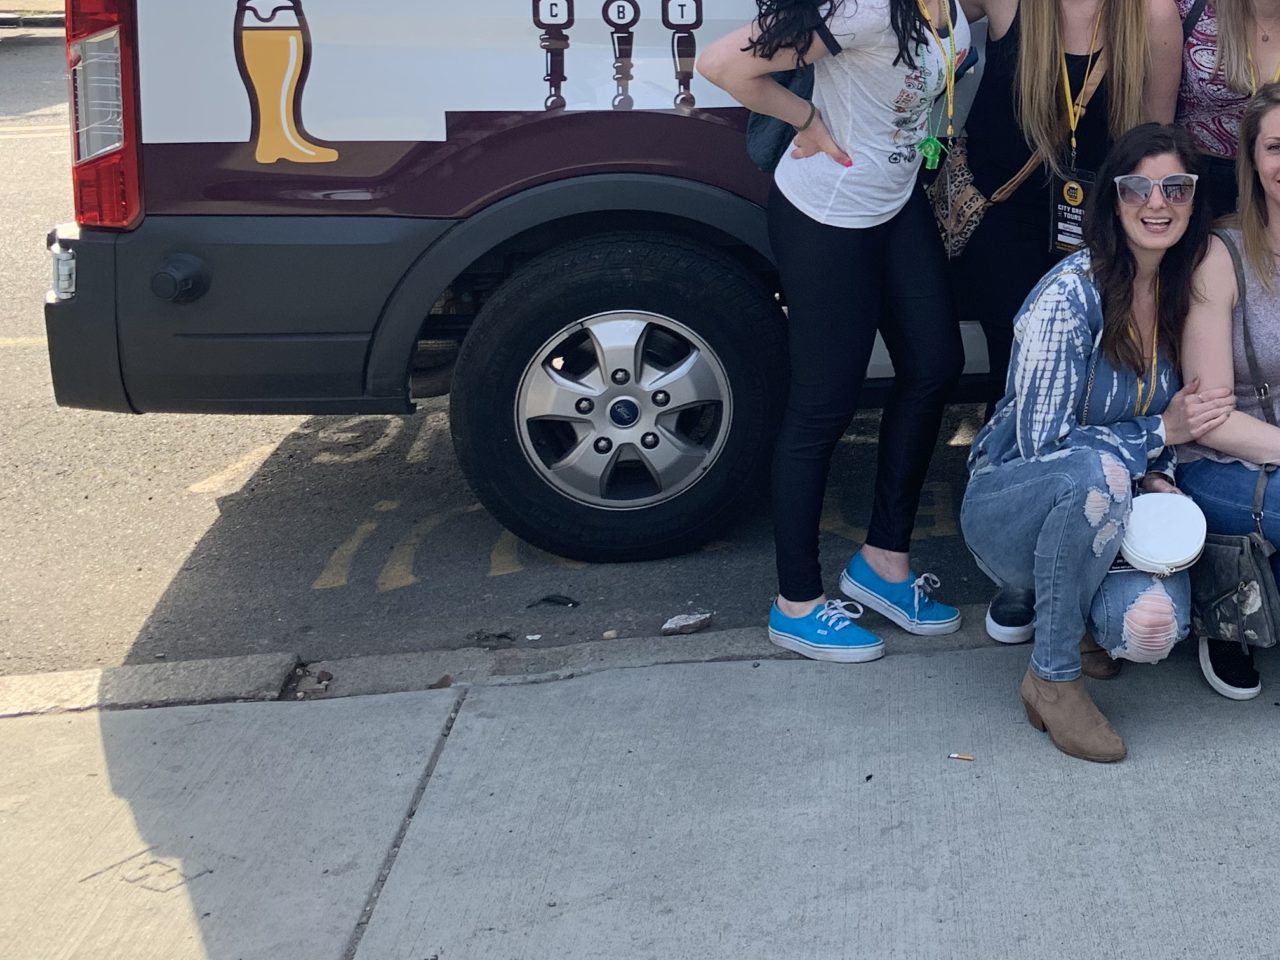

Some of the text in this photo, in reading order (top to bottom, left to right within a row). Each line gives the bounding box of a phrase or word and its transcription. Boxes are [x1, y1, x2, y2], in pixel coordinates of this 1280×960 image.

[549, 2, 687, 20] C B T
[1058, 204, 1071, 212] CITY
[1063, 212, 1082, 221] TOURS
